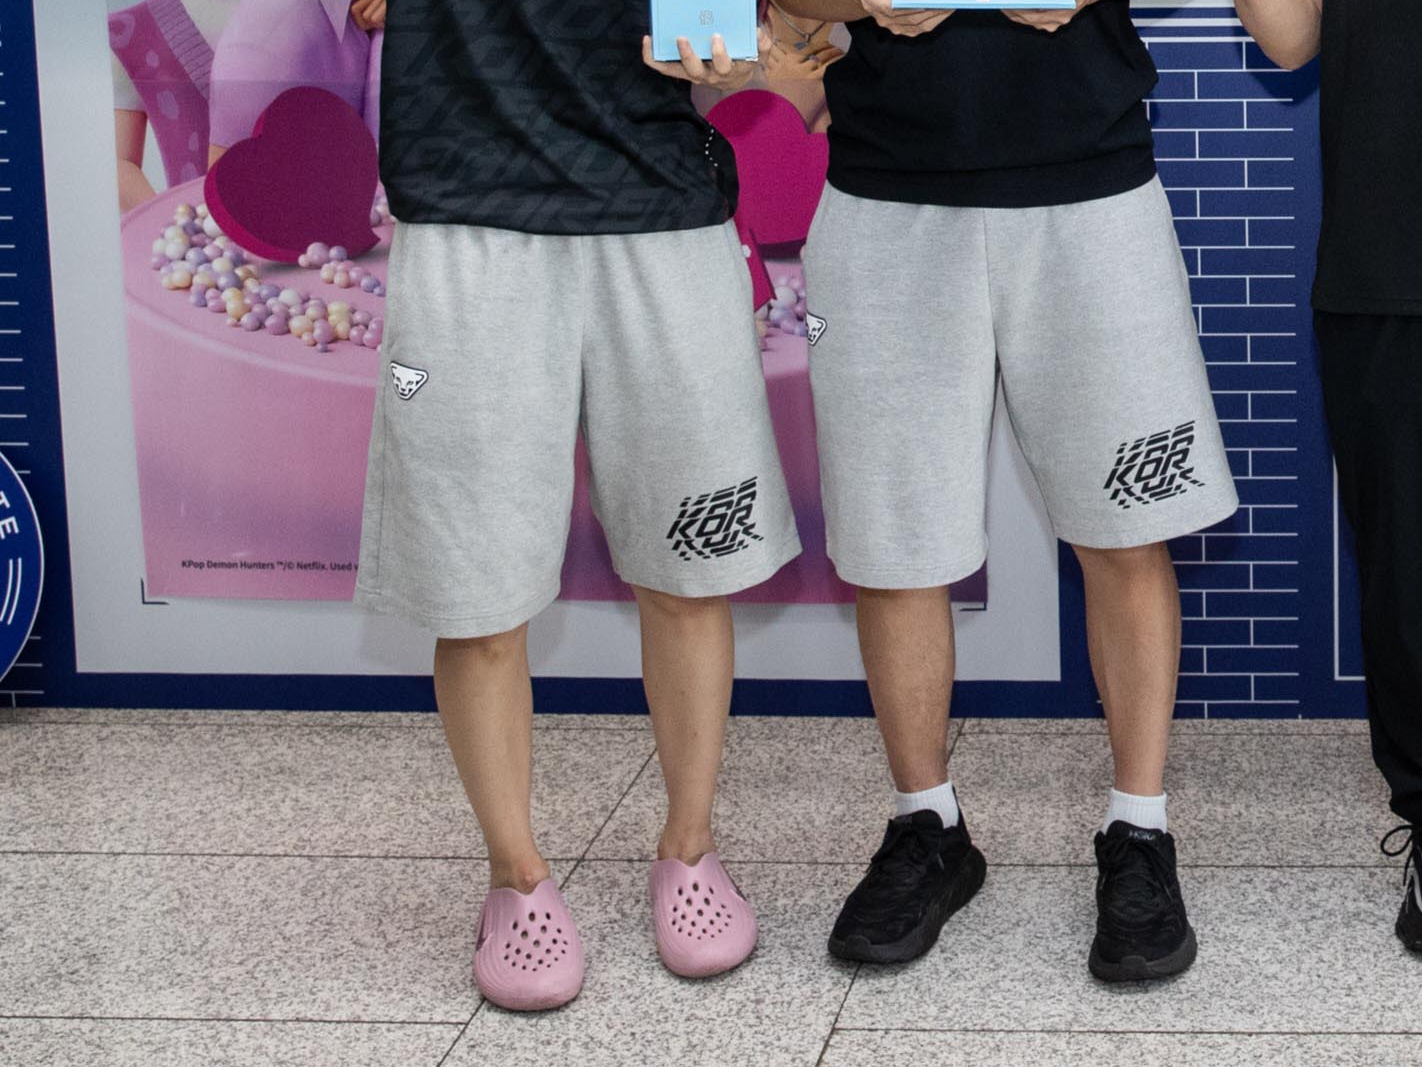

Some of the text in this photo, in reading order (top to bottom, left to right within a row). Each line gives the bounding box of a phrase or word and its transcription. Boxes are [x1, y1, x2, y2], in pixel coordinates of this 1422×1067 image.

[181, 560, 205, 571] KPop
[206, 560, 238, 570] Demon
[239, 561, 275, 570] Hunters
[296, 561, 328, 571] Netflix.
[330, 563, 352, 571] Used
